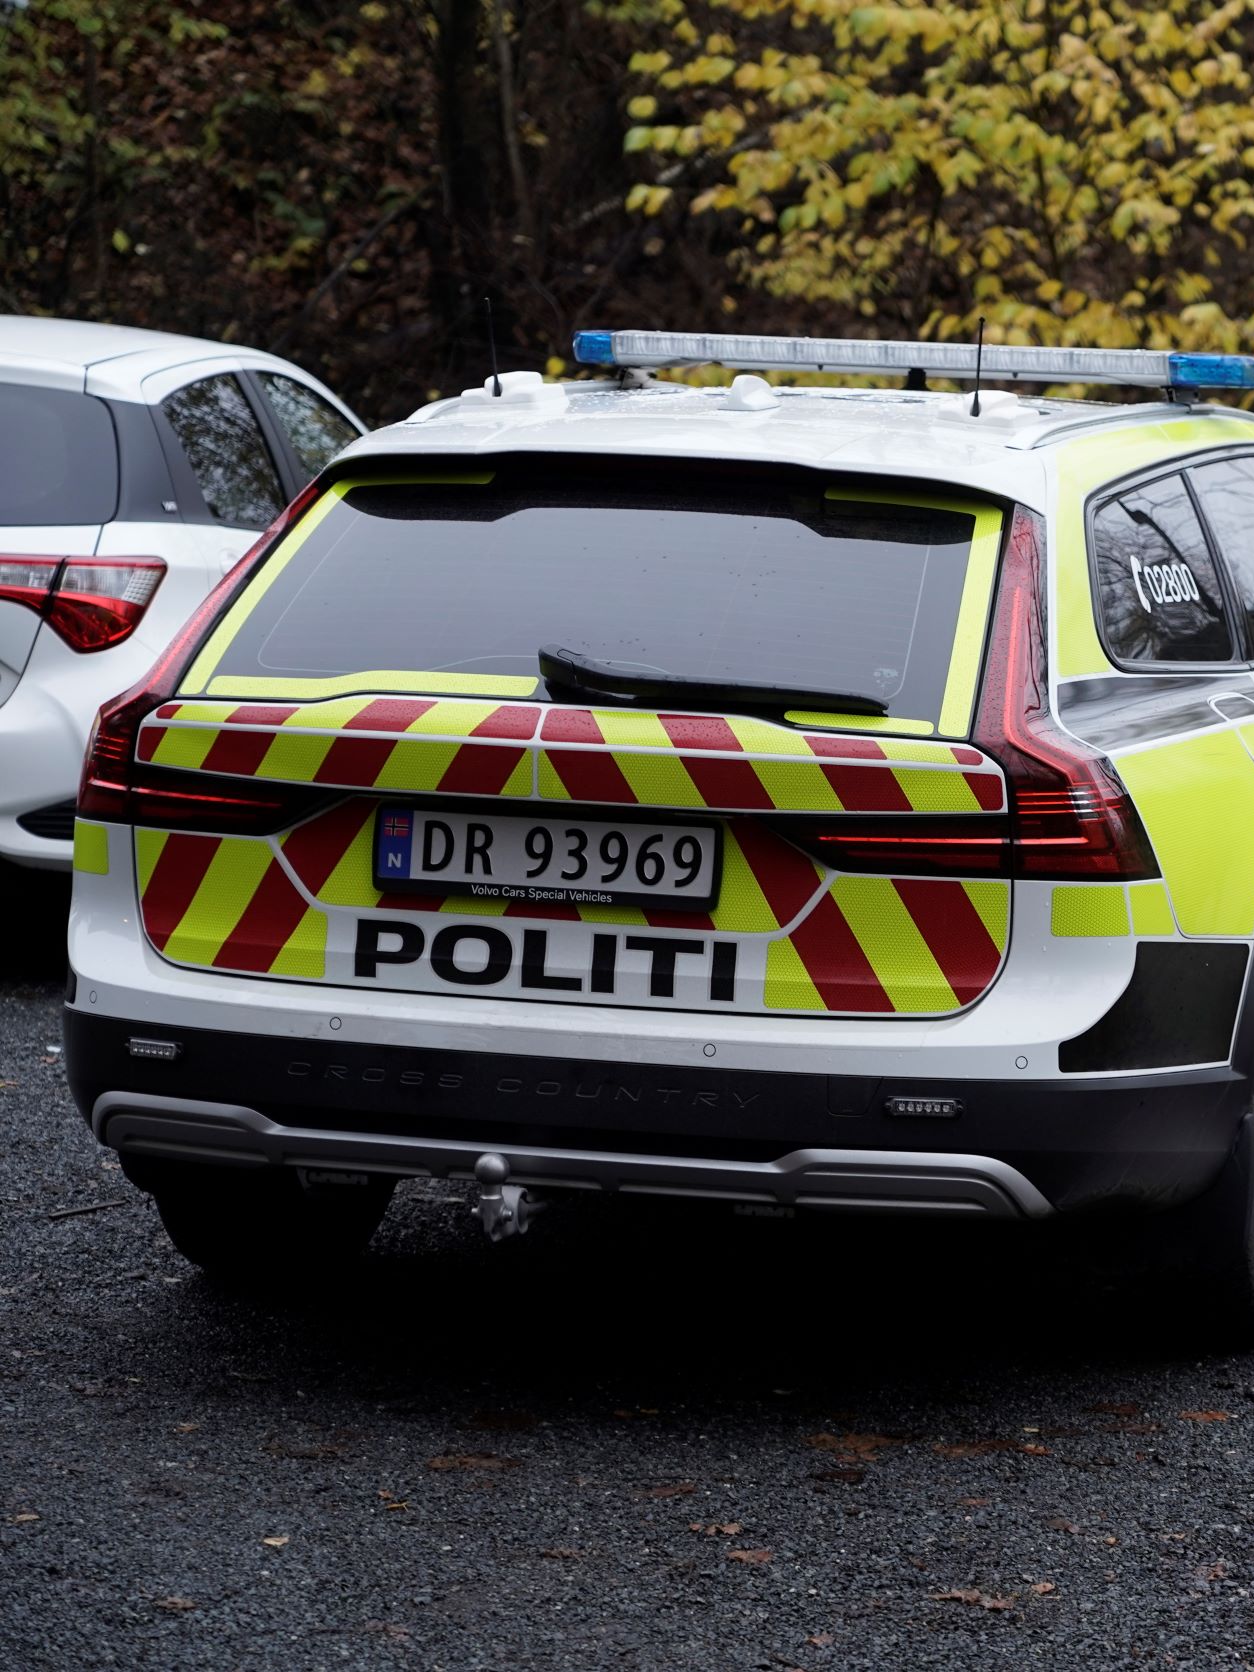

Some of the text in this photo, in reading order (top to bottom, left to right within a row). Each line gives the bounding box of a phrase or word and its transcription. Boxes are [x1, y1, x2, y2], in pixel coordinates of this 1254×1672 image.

[1143, 563, 1200, 604] 02800
[388, 852, 402, 868] N
[422, 820, 703, 887] DR 93969
[471, 884, 612, 903] Volvo Cars Special Vehicles
[354, 919, 738, 1001] POLITI
[288, 1061, 760, 1109] CROSS COUNTRY
